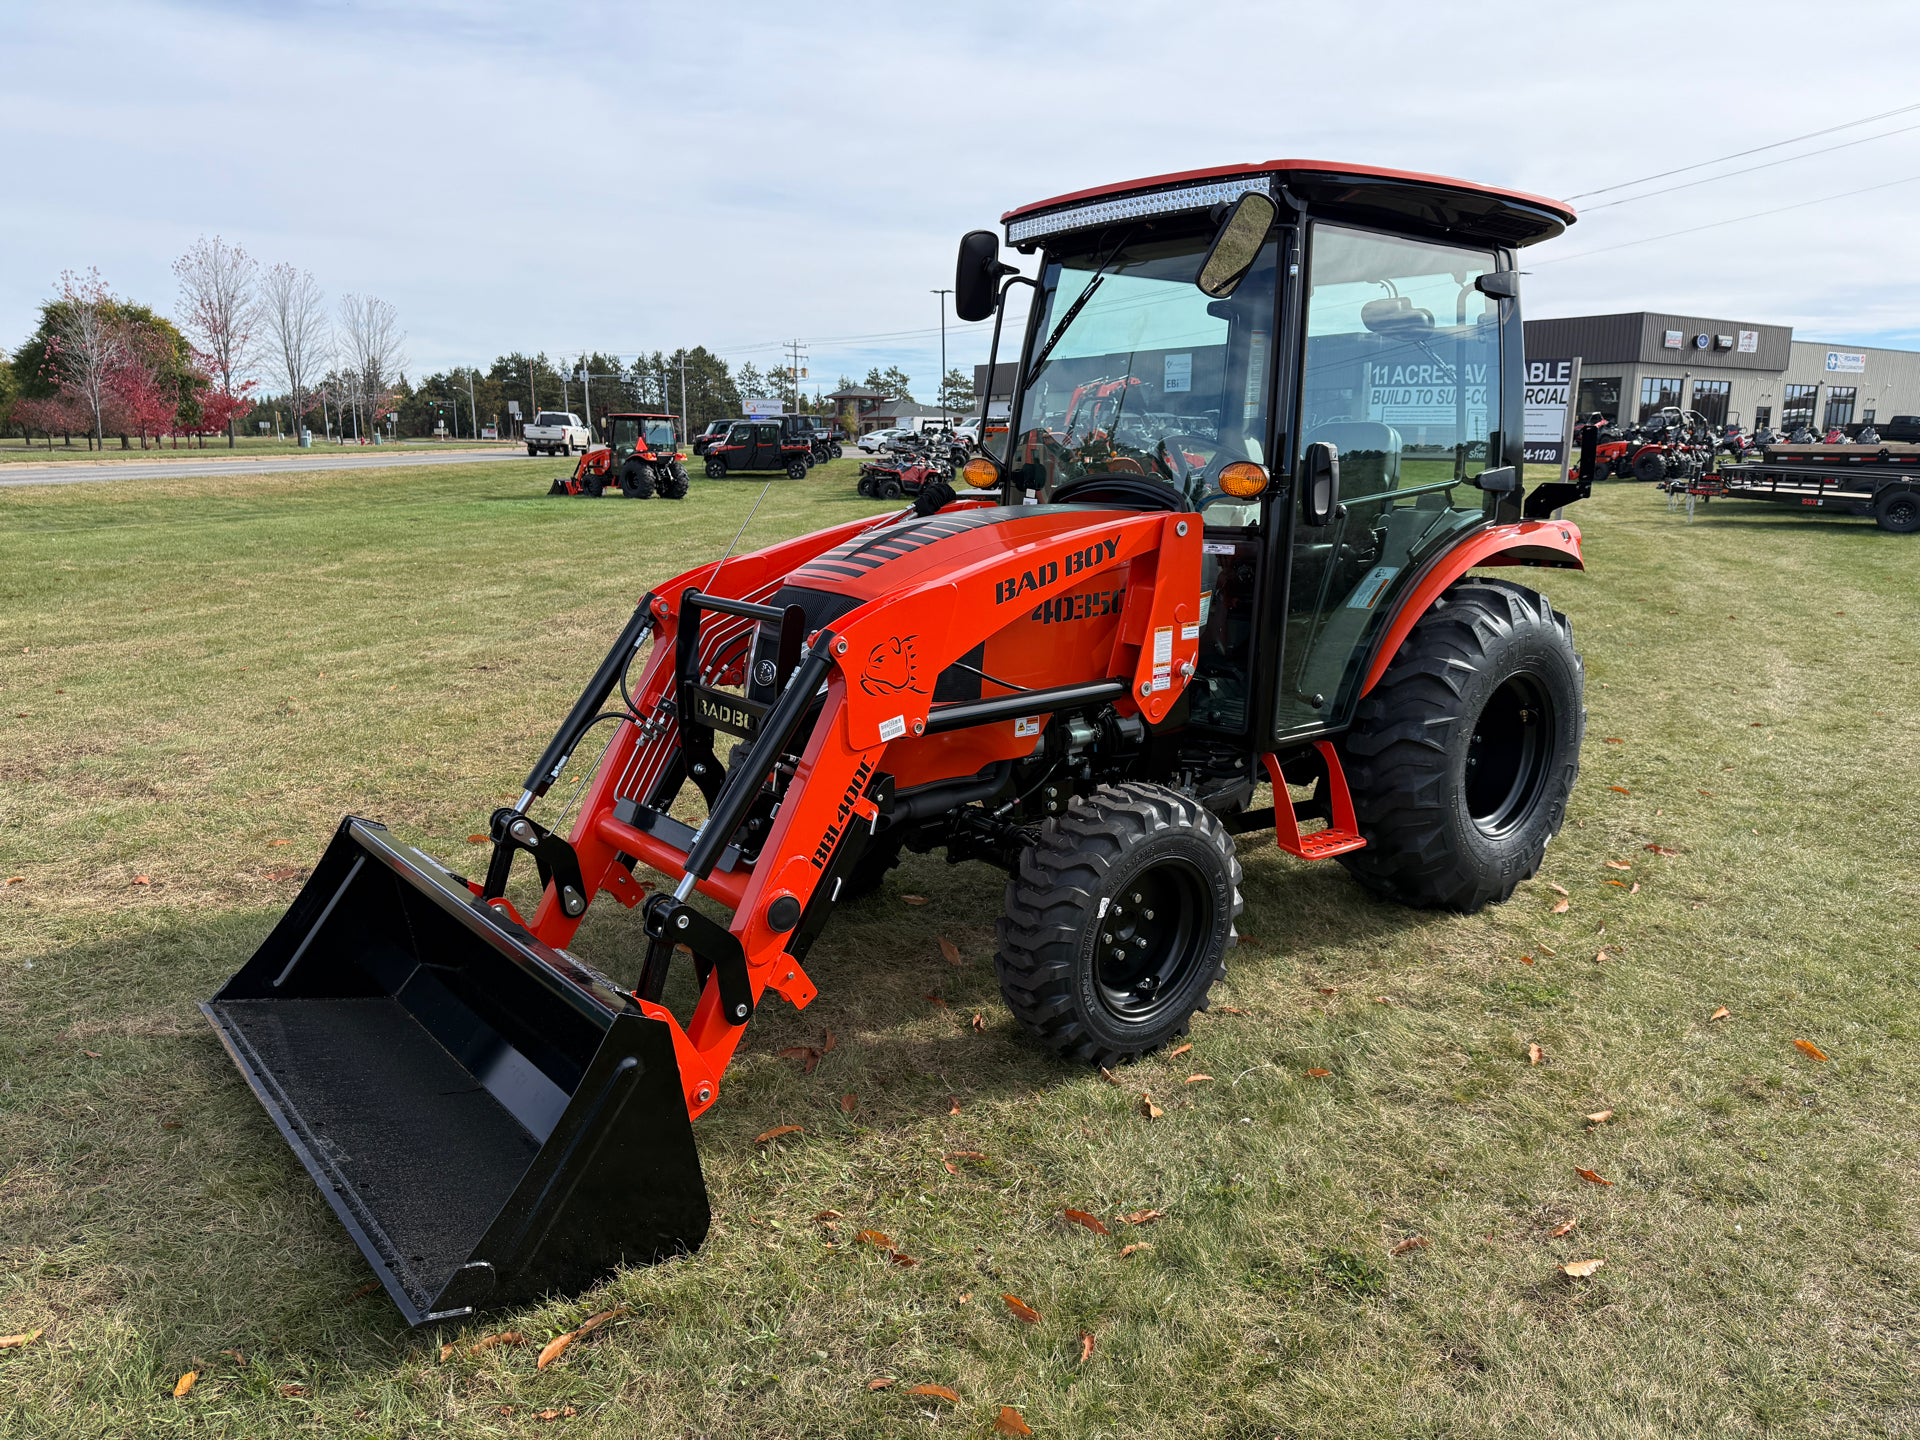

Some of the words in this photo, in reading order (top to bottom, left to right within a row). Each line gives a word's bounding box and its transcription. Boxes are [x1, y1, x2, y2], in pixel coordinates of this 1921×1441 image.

[1371, 389, 1412, 405] BUILD
[1416, 389, 1434, 405] TO
[996, 561, 1059, 605] BAD
[1065, 534, 1122, 577] BOY
[811, 754, 875, 870] BBL400C
